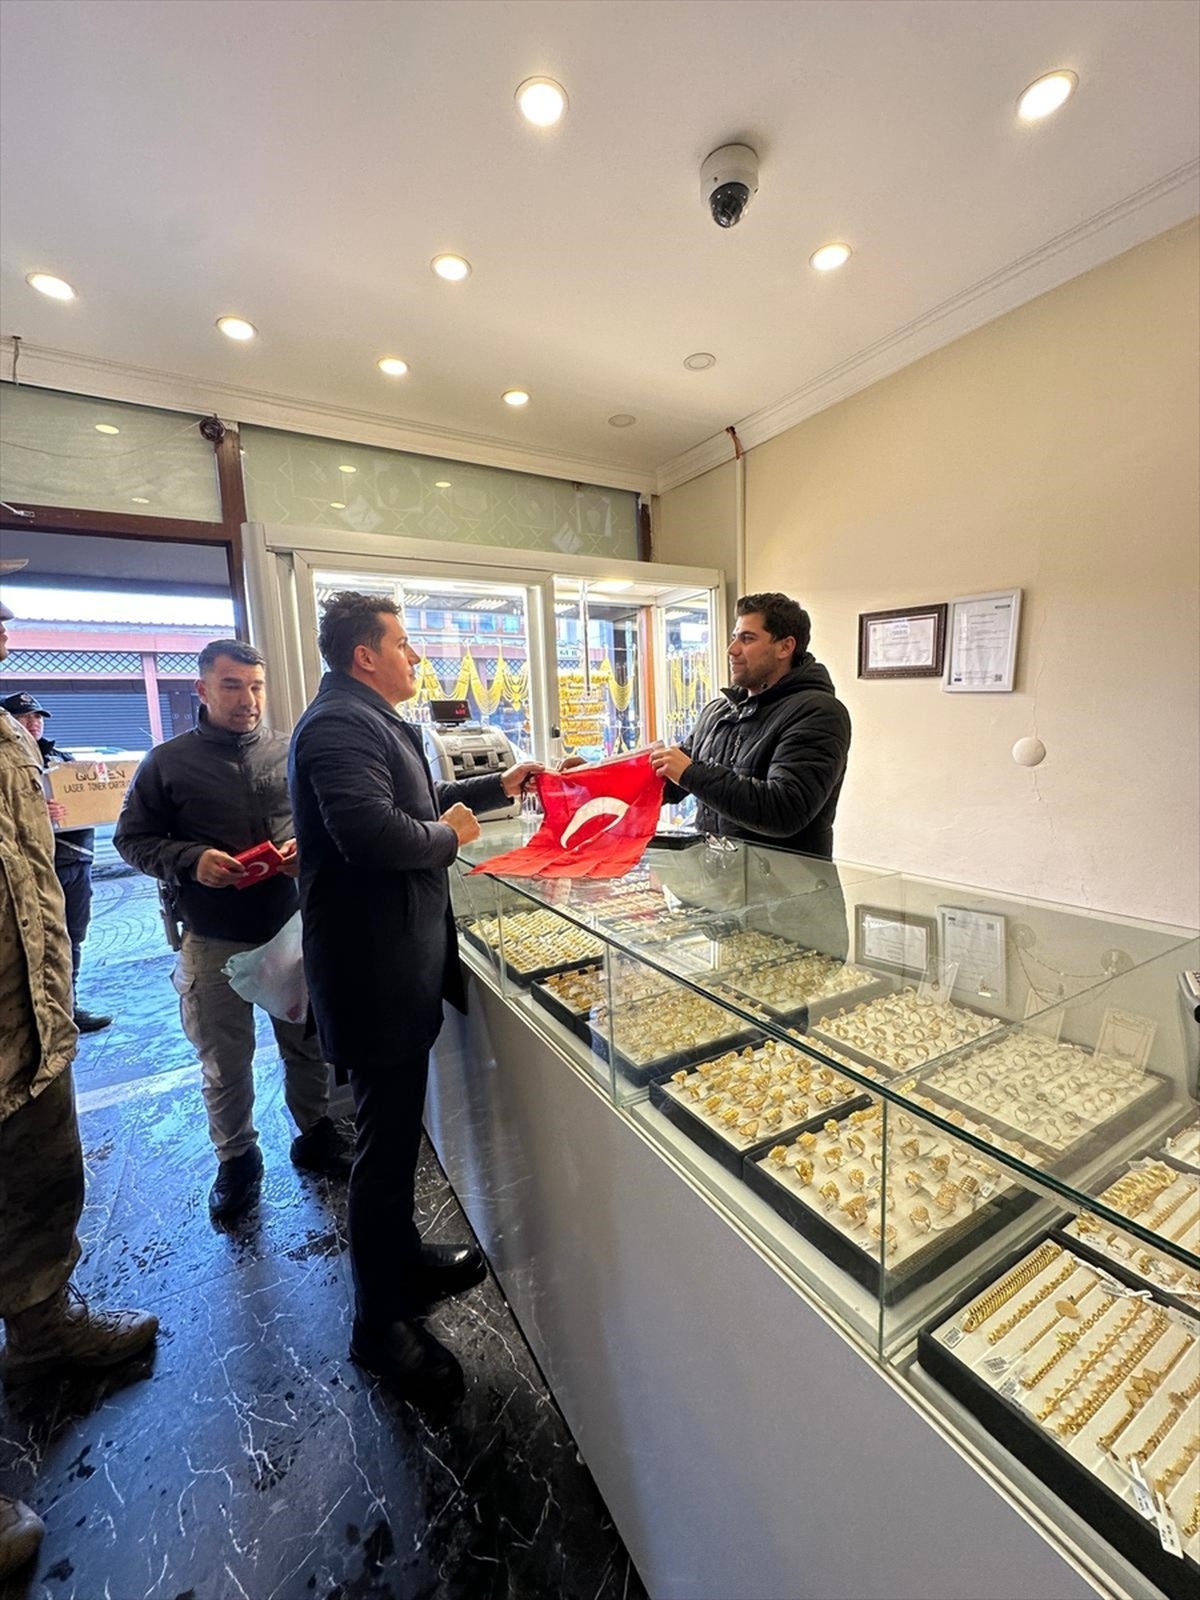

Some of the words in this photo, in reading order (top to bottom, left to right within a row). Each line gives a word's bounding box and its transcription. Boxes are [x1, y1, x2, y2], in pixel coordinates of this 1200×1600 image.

[75, 770, 126, 781] QUEN
[63, 783, 85, 794] LASER
[88, 782, 107, 792] TONER
